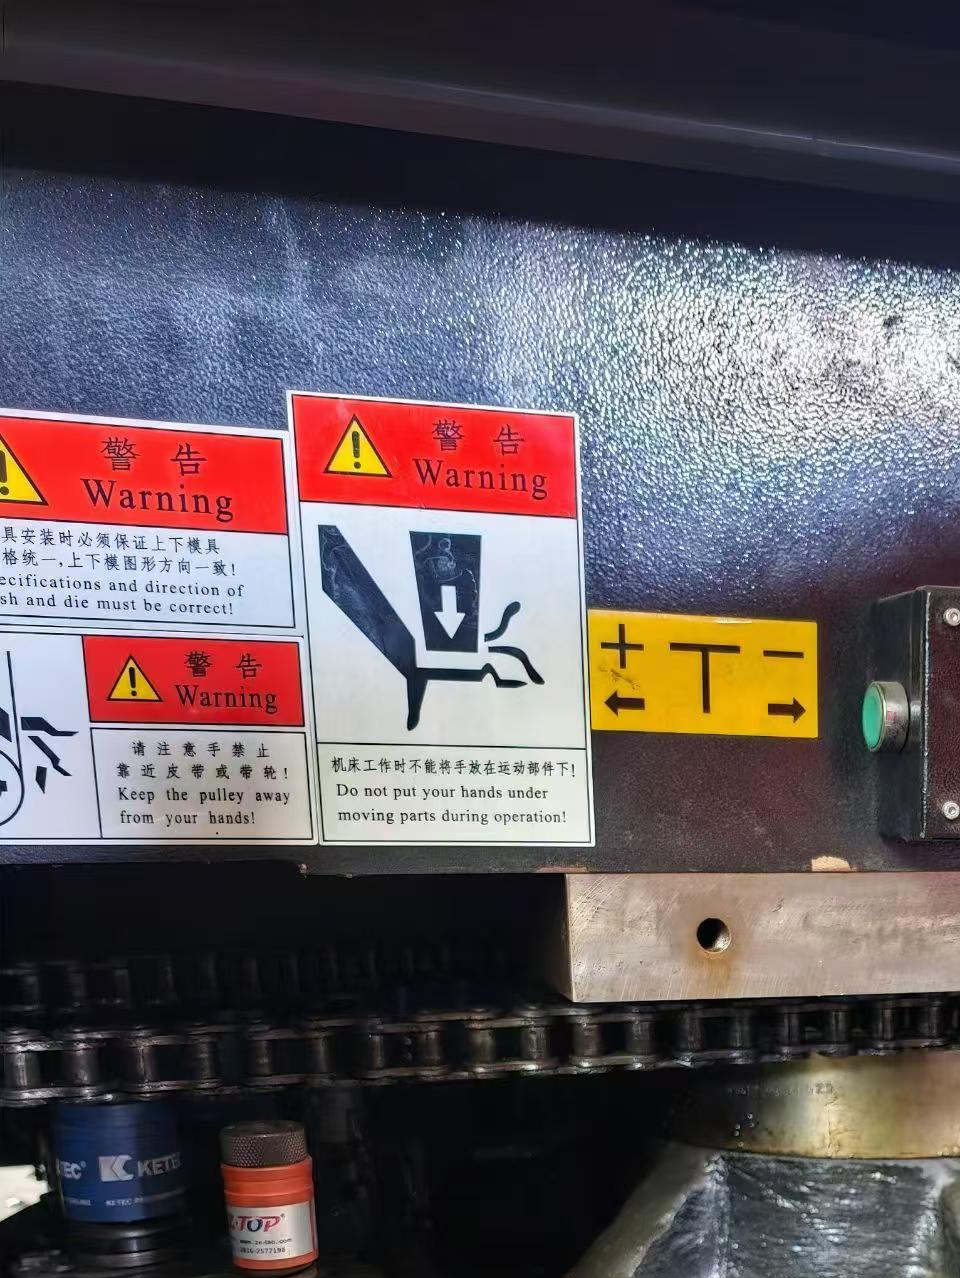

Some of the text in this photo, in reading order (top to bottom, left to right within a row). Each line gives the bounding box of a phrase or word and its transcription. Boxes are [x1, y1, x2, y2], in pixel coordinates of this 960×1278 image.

[432, 419, 524, 456] 警告
[100, 437, 207, 476] 警告
[412, 458, 548, 500] Warning
[80, 478, 234, 523] Warning
[109, 580, 138, 593] and
[145, 581, 220, 597] direction
[227, 585, 244, 598] of
[26, 595, 56, 607] and
[64, 595, 89, 608] die
[97, 598, 136, 610] must
[144, 599, 162, 612] be
[170, 601, 233, 615] correct!
[185, 651, 262, 679] 警告
[670, 642, 740, 713] T
[174, 684, 278, 714] Warning
[131, 741, 270, 758] 请注意手禁止
[117, 788, 290, 805] Keep the pulley away
[336, 784, 548, 801] Do not put your hands under
[120, 810, 255, 827] from your hands!
[338, 809, 567, 825] moving parts during operation!
